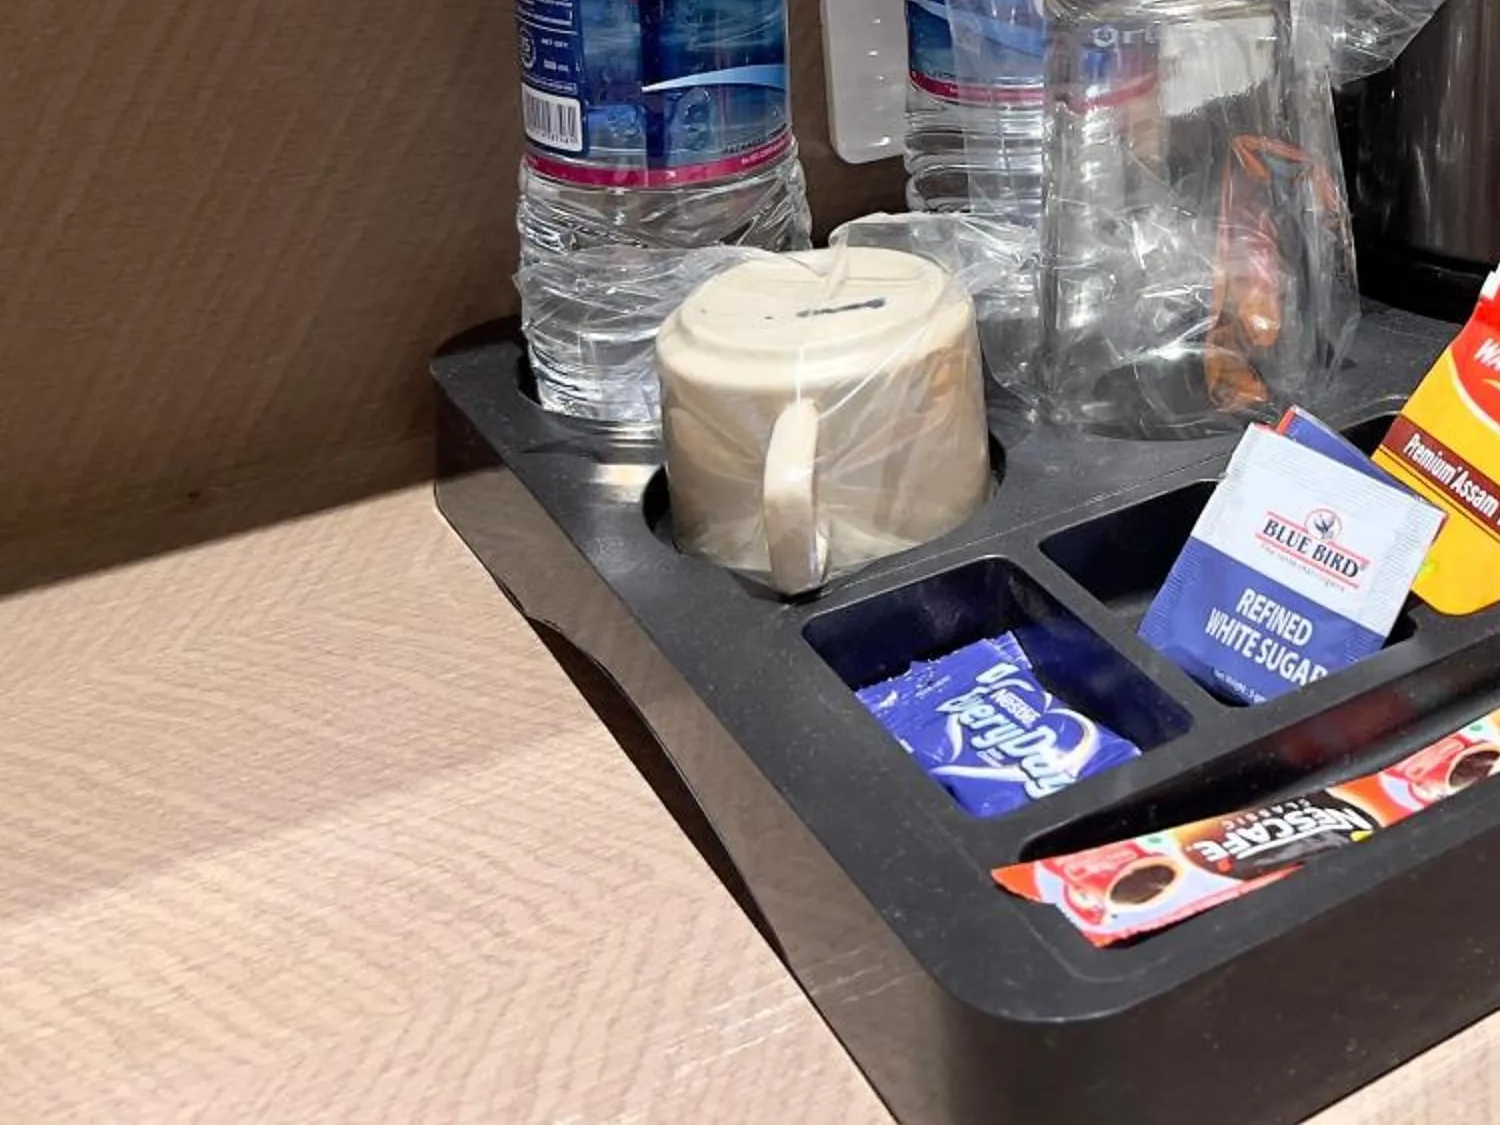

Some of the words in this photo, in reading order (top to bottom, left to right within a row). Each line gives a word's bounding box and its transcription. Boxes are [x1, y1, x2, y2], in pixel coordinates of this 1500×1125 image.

[1450, 470, 1500, 517] Assam
[1263, 518, 1313, 553] BLUE
[1312, 544, 1361, 579] BIRD
[1204, 607, 1259, 658] WHITE
[1235, 588, 1313, 646] REFINED
